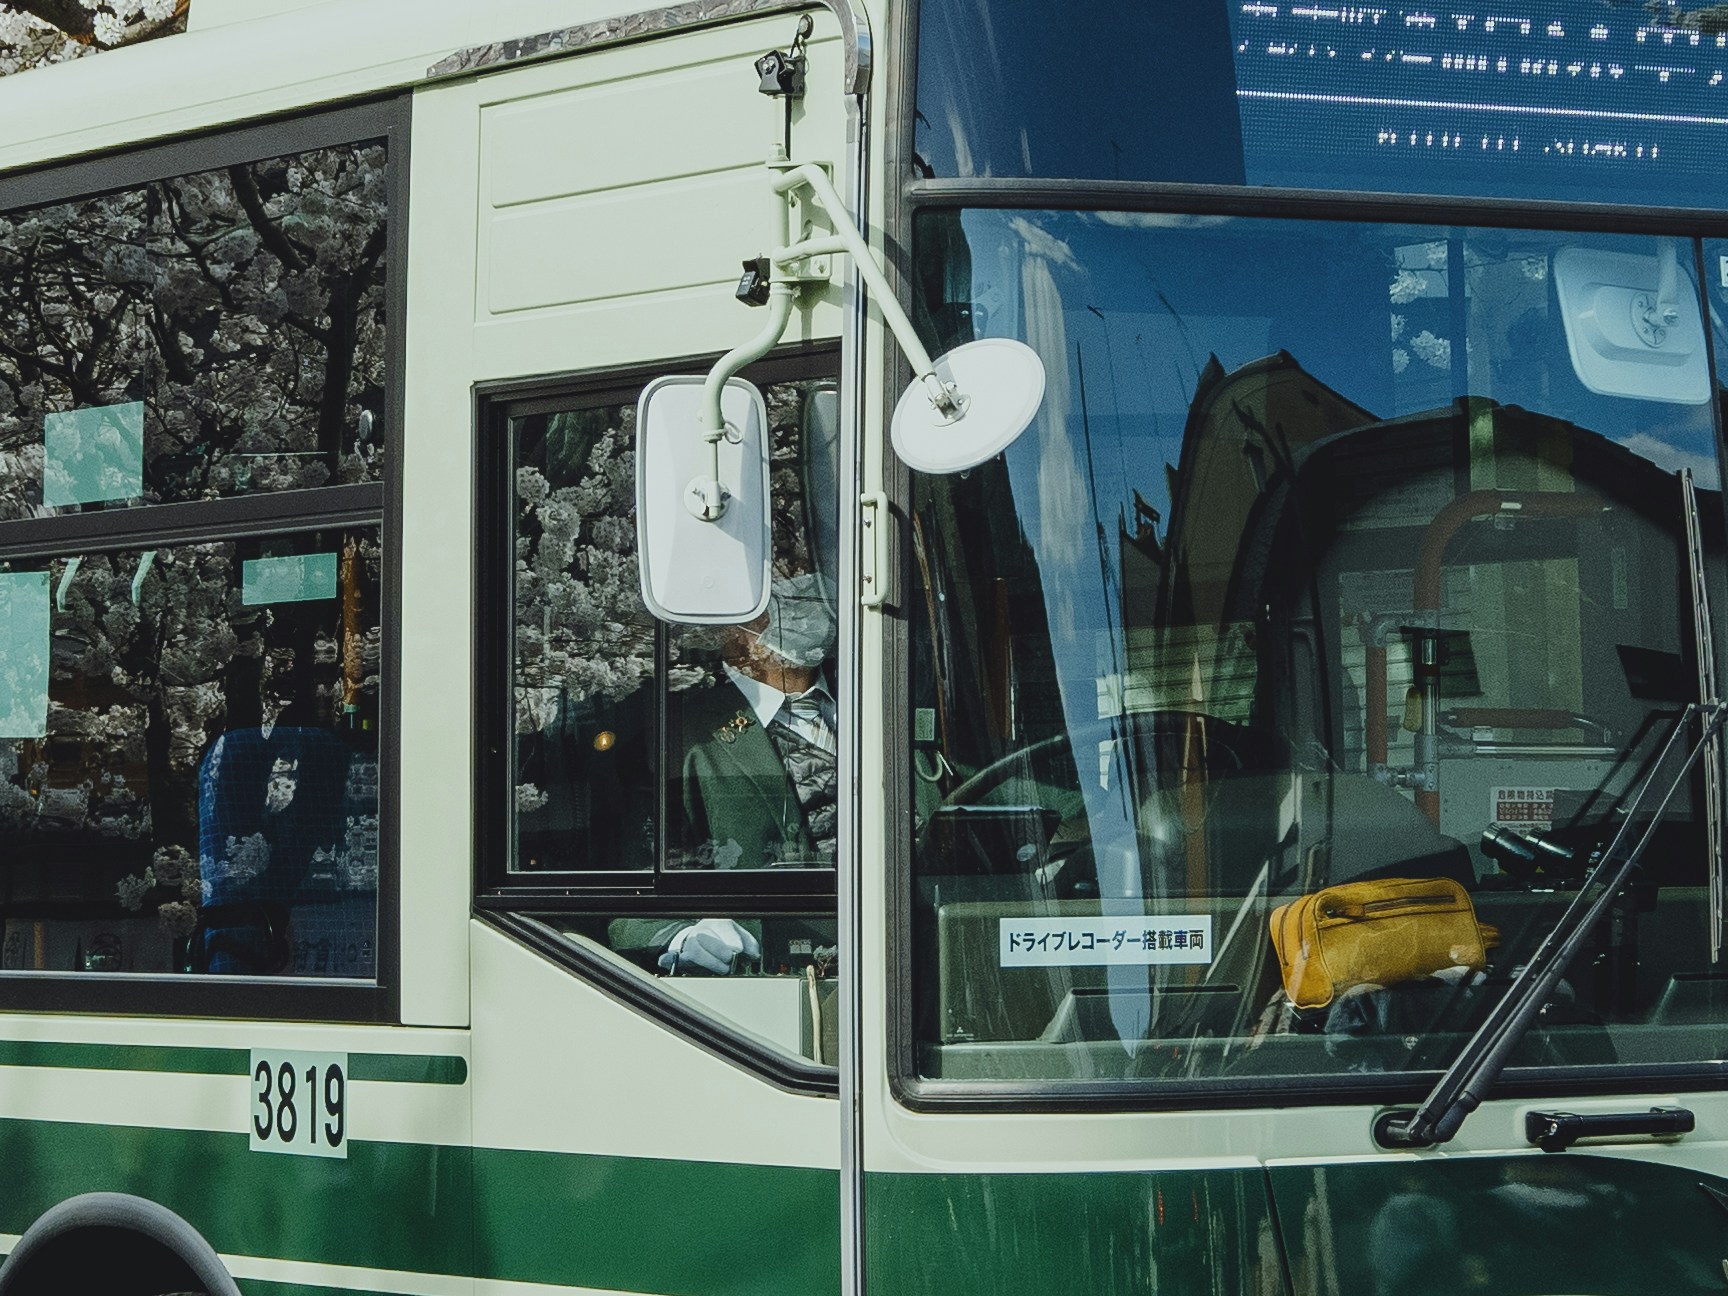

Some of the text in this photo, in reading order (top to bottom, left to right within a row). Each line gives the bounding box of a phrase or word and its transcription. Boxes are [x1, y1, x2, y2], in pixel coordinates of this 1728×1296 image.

[1009, 929, 1204, 953] ドライブレコーダー搭載車両
[254, 1060, 345, 1148] 3819
